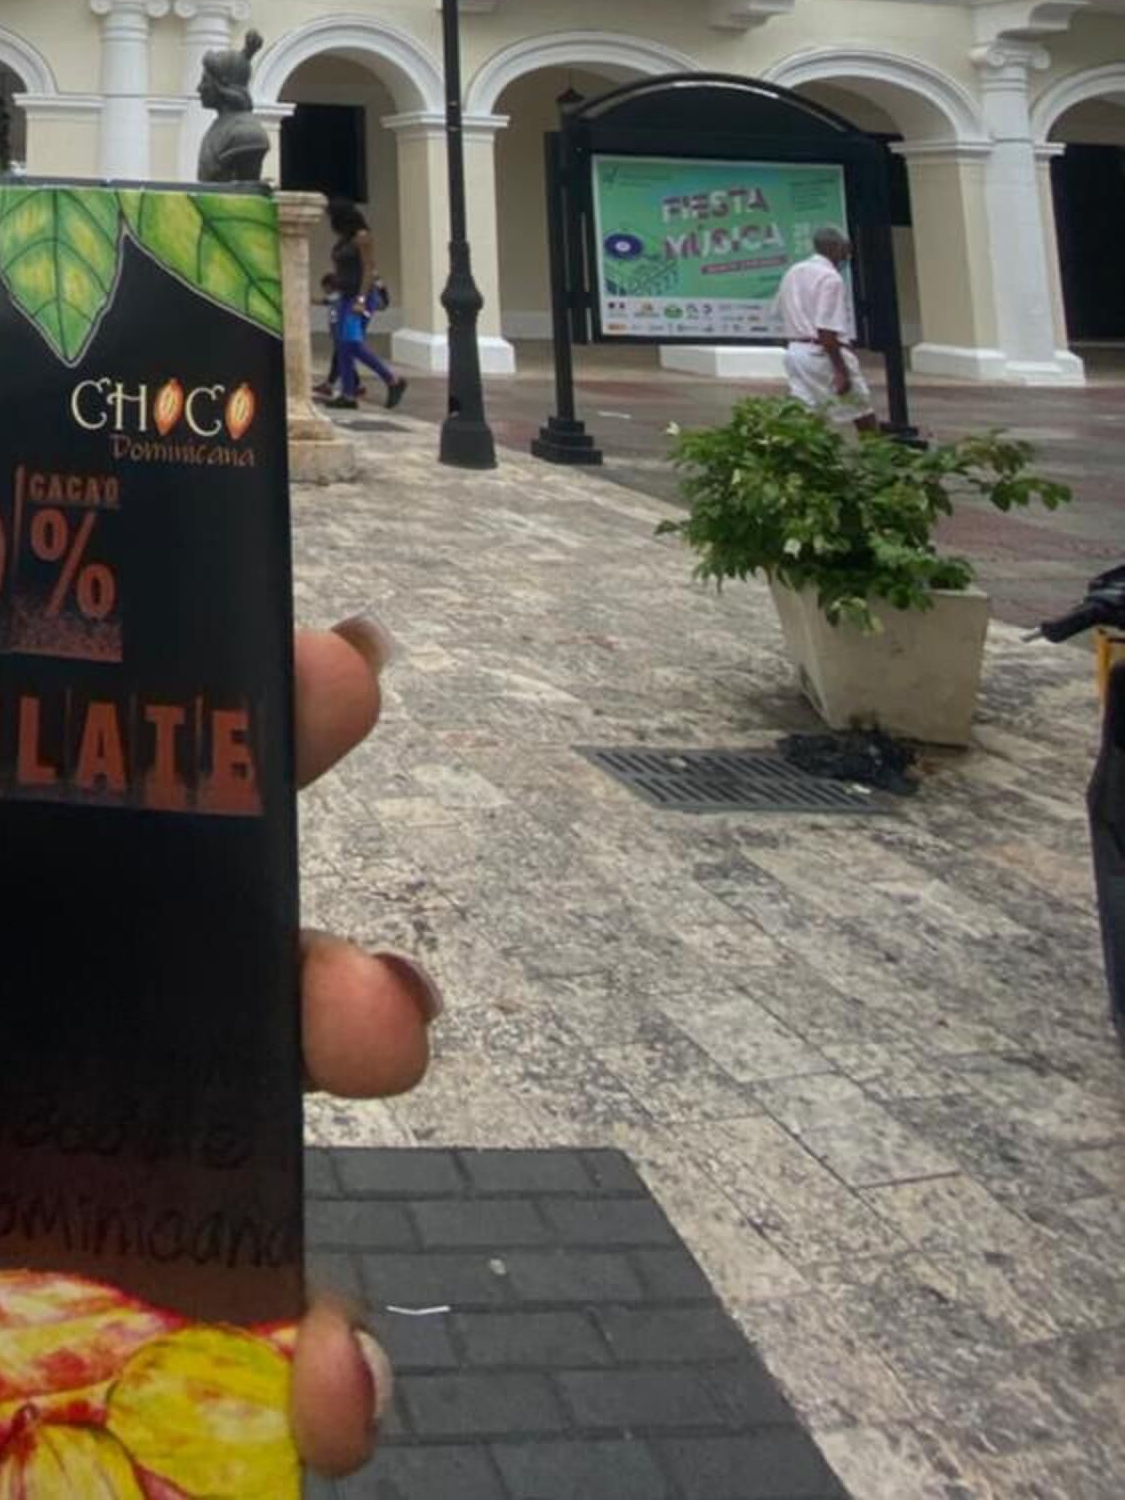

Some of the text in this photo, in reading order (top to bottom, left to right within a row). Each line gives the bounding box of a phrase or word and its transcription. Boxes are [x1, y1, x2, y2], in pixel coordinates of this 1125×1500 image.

[71, 376, 255, 441] CHOCO
[110, 433, 255, 468] Dominicana
[29, 472, 119, 503] CACAO
